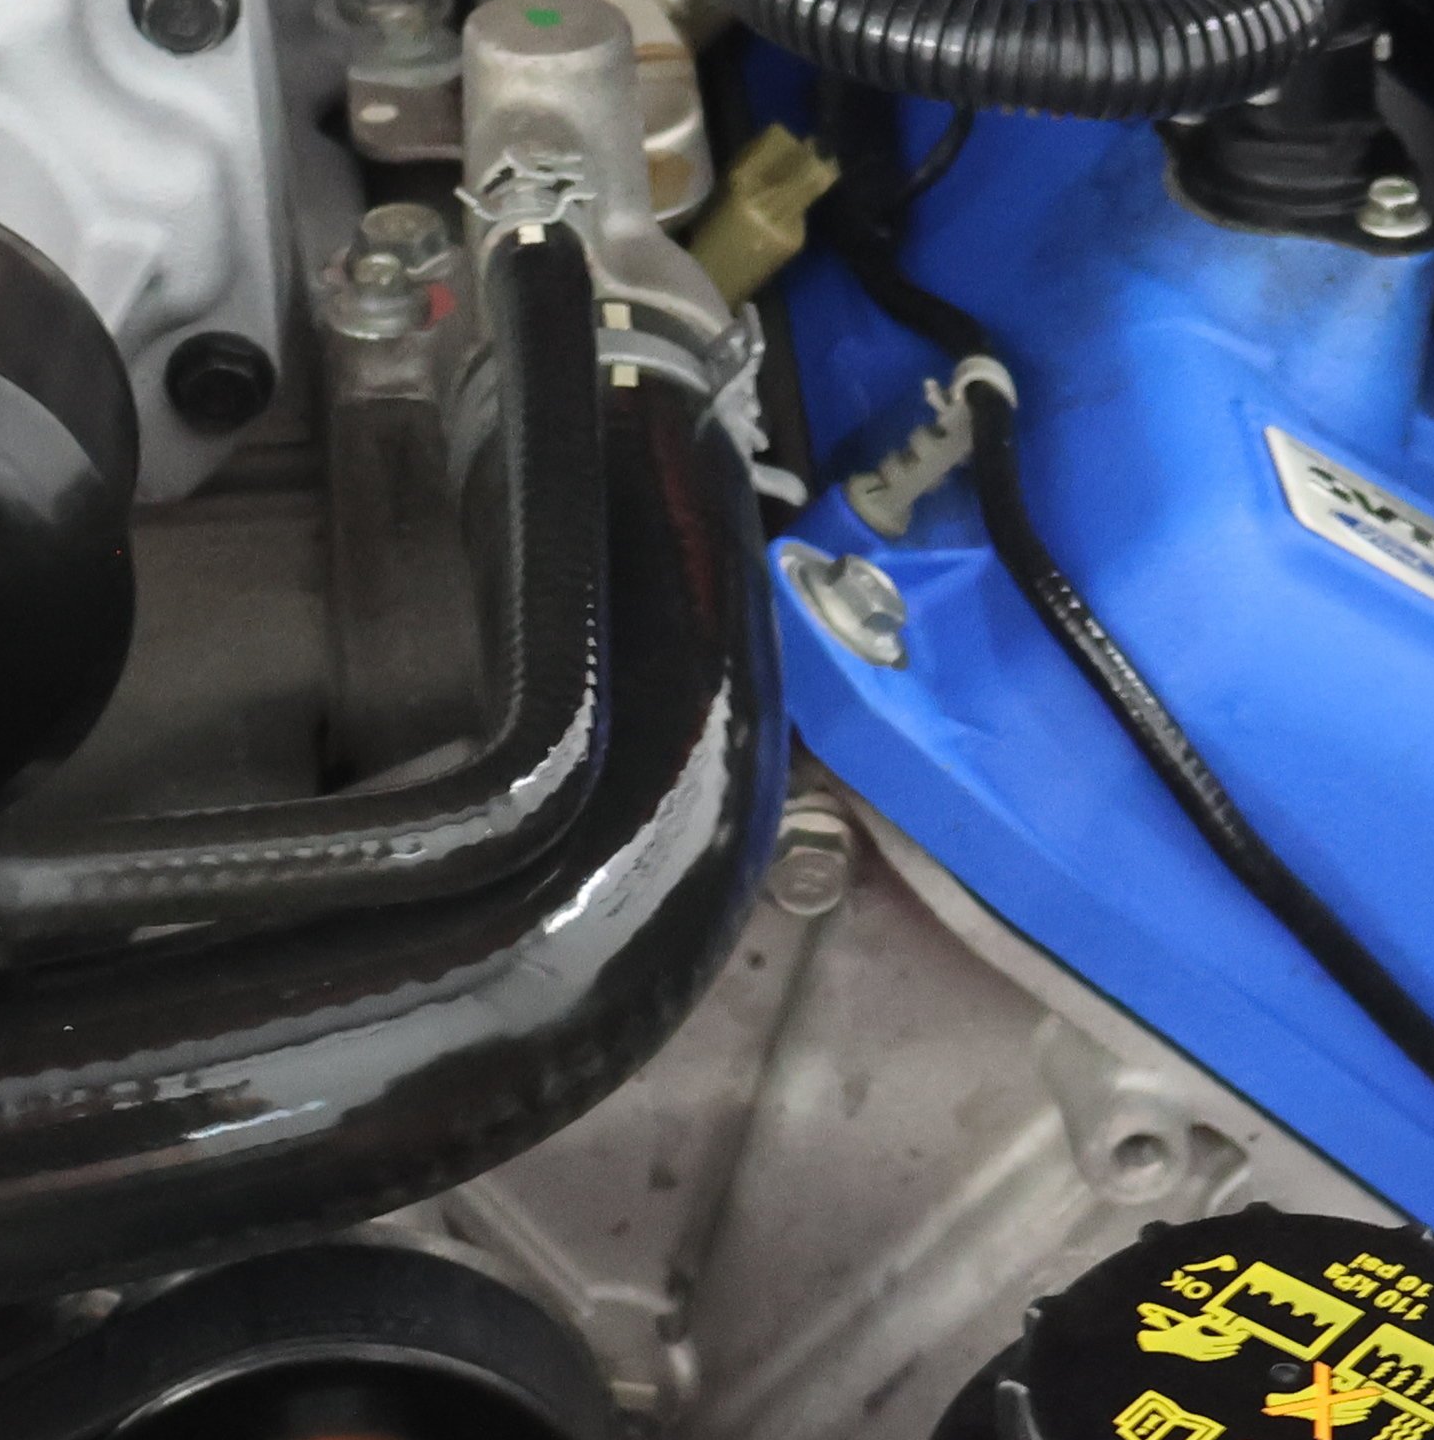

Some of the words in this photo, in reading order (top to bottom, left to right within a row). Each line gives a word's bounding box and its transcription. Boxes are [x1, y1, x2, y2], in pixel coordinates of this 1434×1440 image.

[1322, 1262, 1381, 1299] kPa
[1347, 1252, 1405, 1279] psi
[1160, 1270, 1214, 1300] OK
[1373, 1289, 1429, 1322] 110
